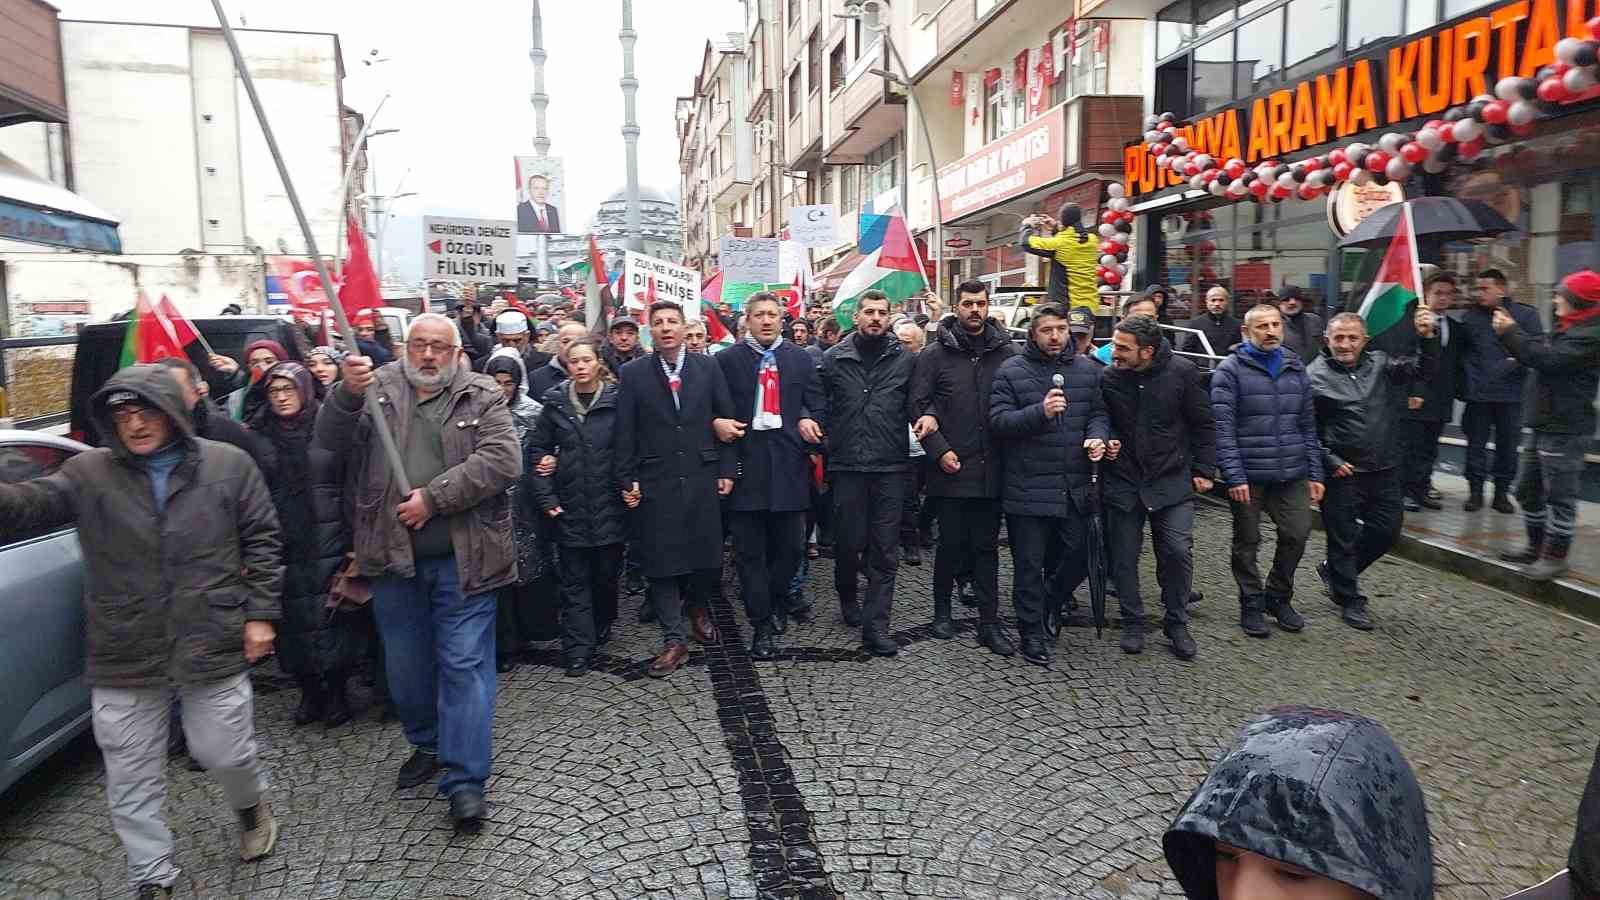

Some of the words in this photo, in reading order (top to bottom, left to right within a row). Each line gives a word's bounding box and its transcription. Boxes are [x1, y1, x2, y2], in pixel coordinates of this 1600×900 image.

[1247, 58, 1377, 163] ARAMA
[446, 239, 494, 257] ÖZGÜR
[437, 257, 505, 277] FİLİSTİN
[633, 272, 695, 302] DİENİŞE
